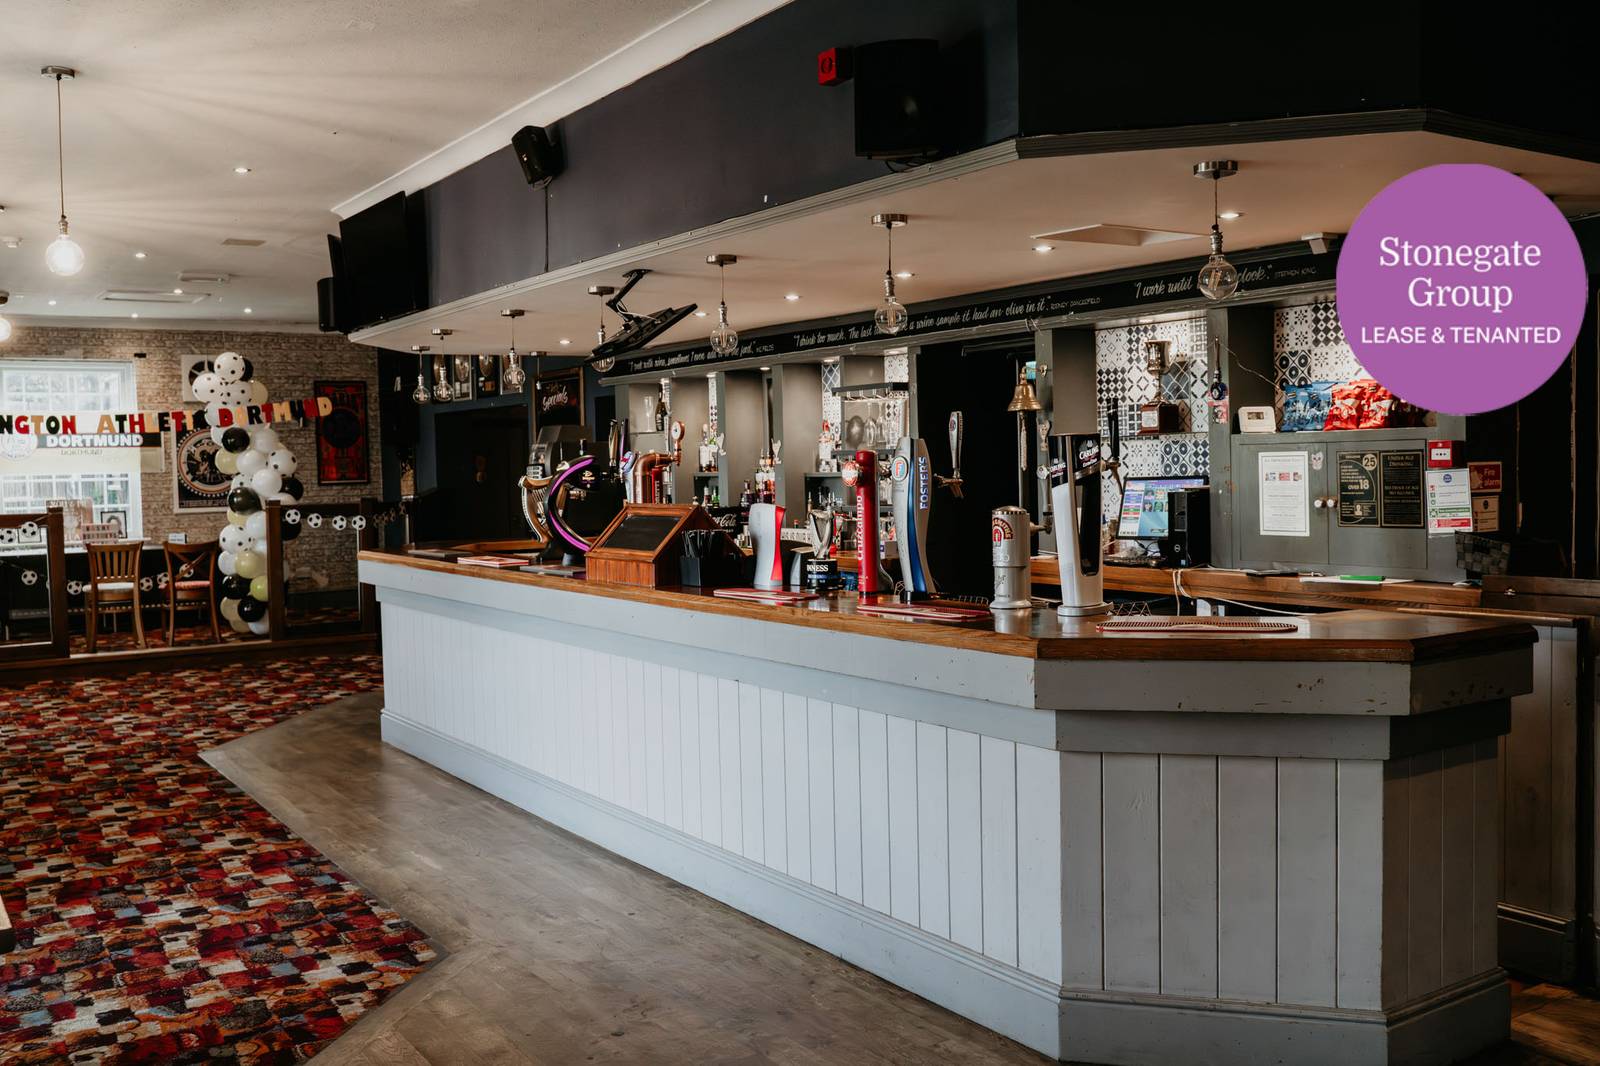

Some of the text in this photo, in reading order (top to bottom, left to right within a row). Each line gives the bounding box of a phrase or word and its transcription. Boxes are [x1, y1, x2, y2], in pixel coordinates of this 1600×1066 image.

[1142, 280, 1165, 297] work
[1167, 276, 1193, 294] until
[849, 326, 860, 339] The
[860, 325, 872, 338] last
[962, 310, 970, 322] it
[972, 305, 989, 321] had
[990, 308, 1002, 318] an
[1005, 301, 1024, 317] olive
[1026, 301, 1036, 314] in
[218, 396, 334, 428] DORTMUND
[46, 433, 144, 448] DORTMUND
[1364, 457, 1376, 467] 25
[1483, 467, 1496, 477] Fire
[919, 456, 929, 510] FOSTER'S
[1359, 479, 1370, 490] 18
[856, 495, 865, 561] Cruzcampo
